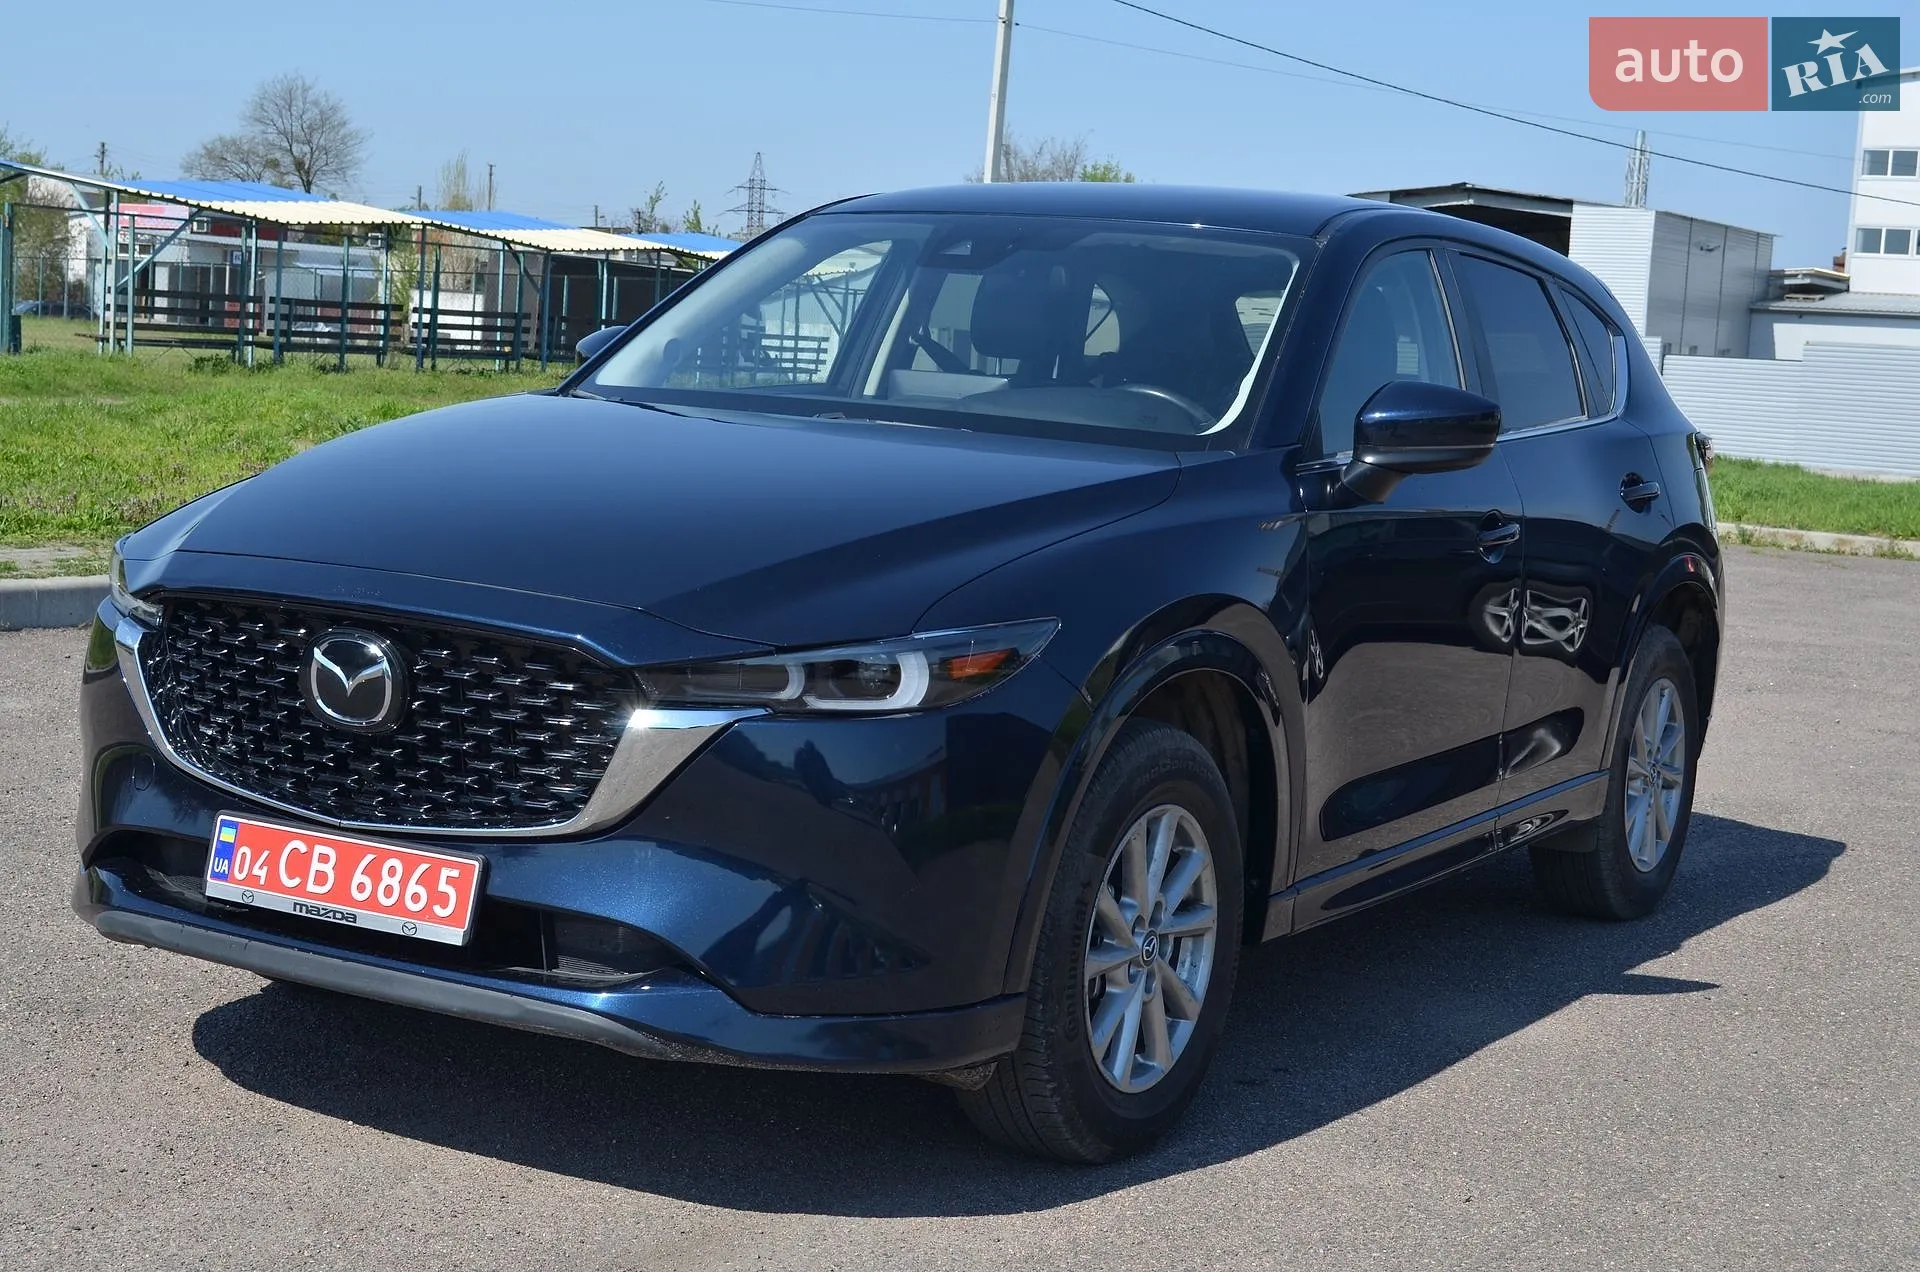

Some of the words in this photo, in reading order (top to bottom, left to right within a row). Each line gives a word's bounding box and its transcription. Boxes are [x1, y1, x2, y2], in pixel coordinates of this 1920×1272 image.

[213, 857, 229, 875] UA
[233, 846, 271, 886] 04
[278, 839, 338, 895] CB
[350, 853, 461, 918] 6865
